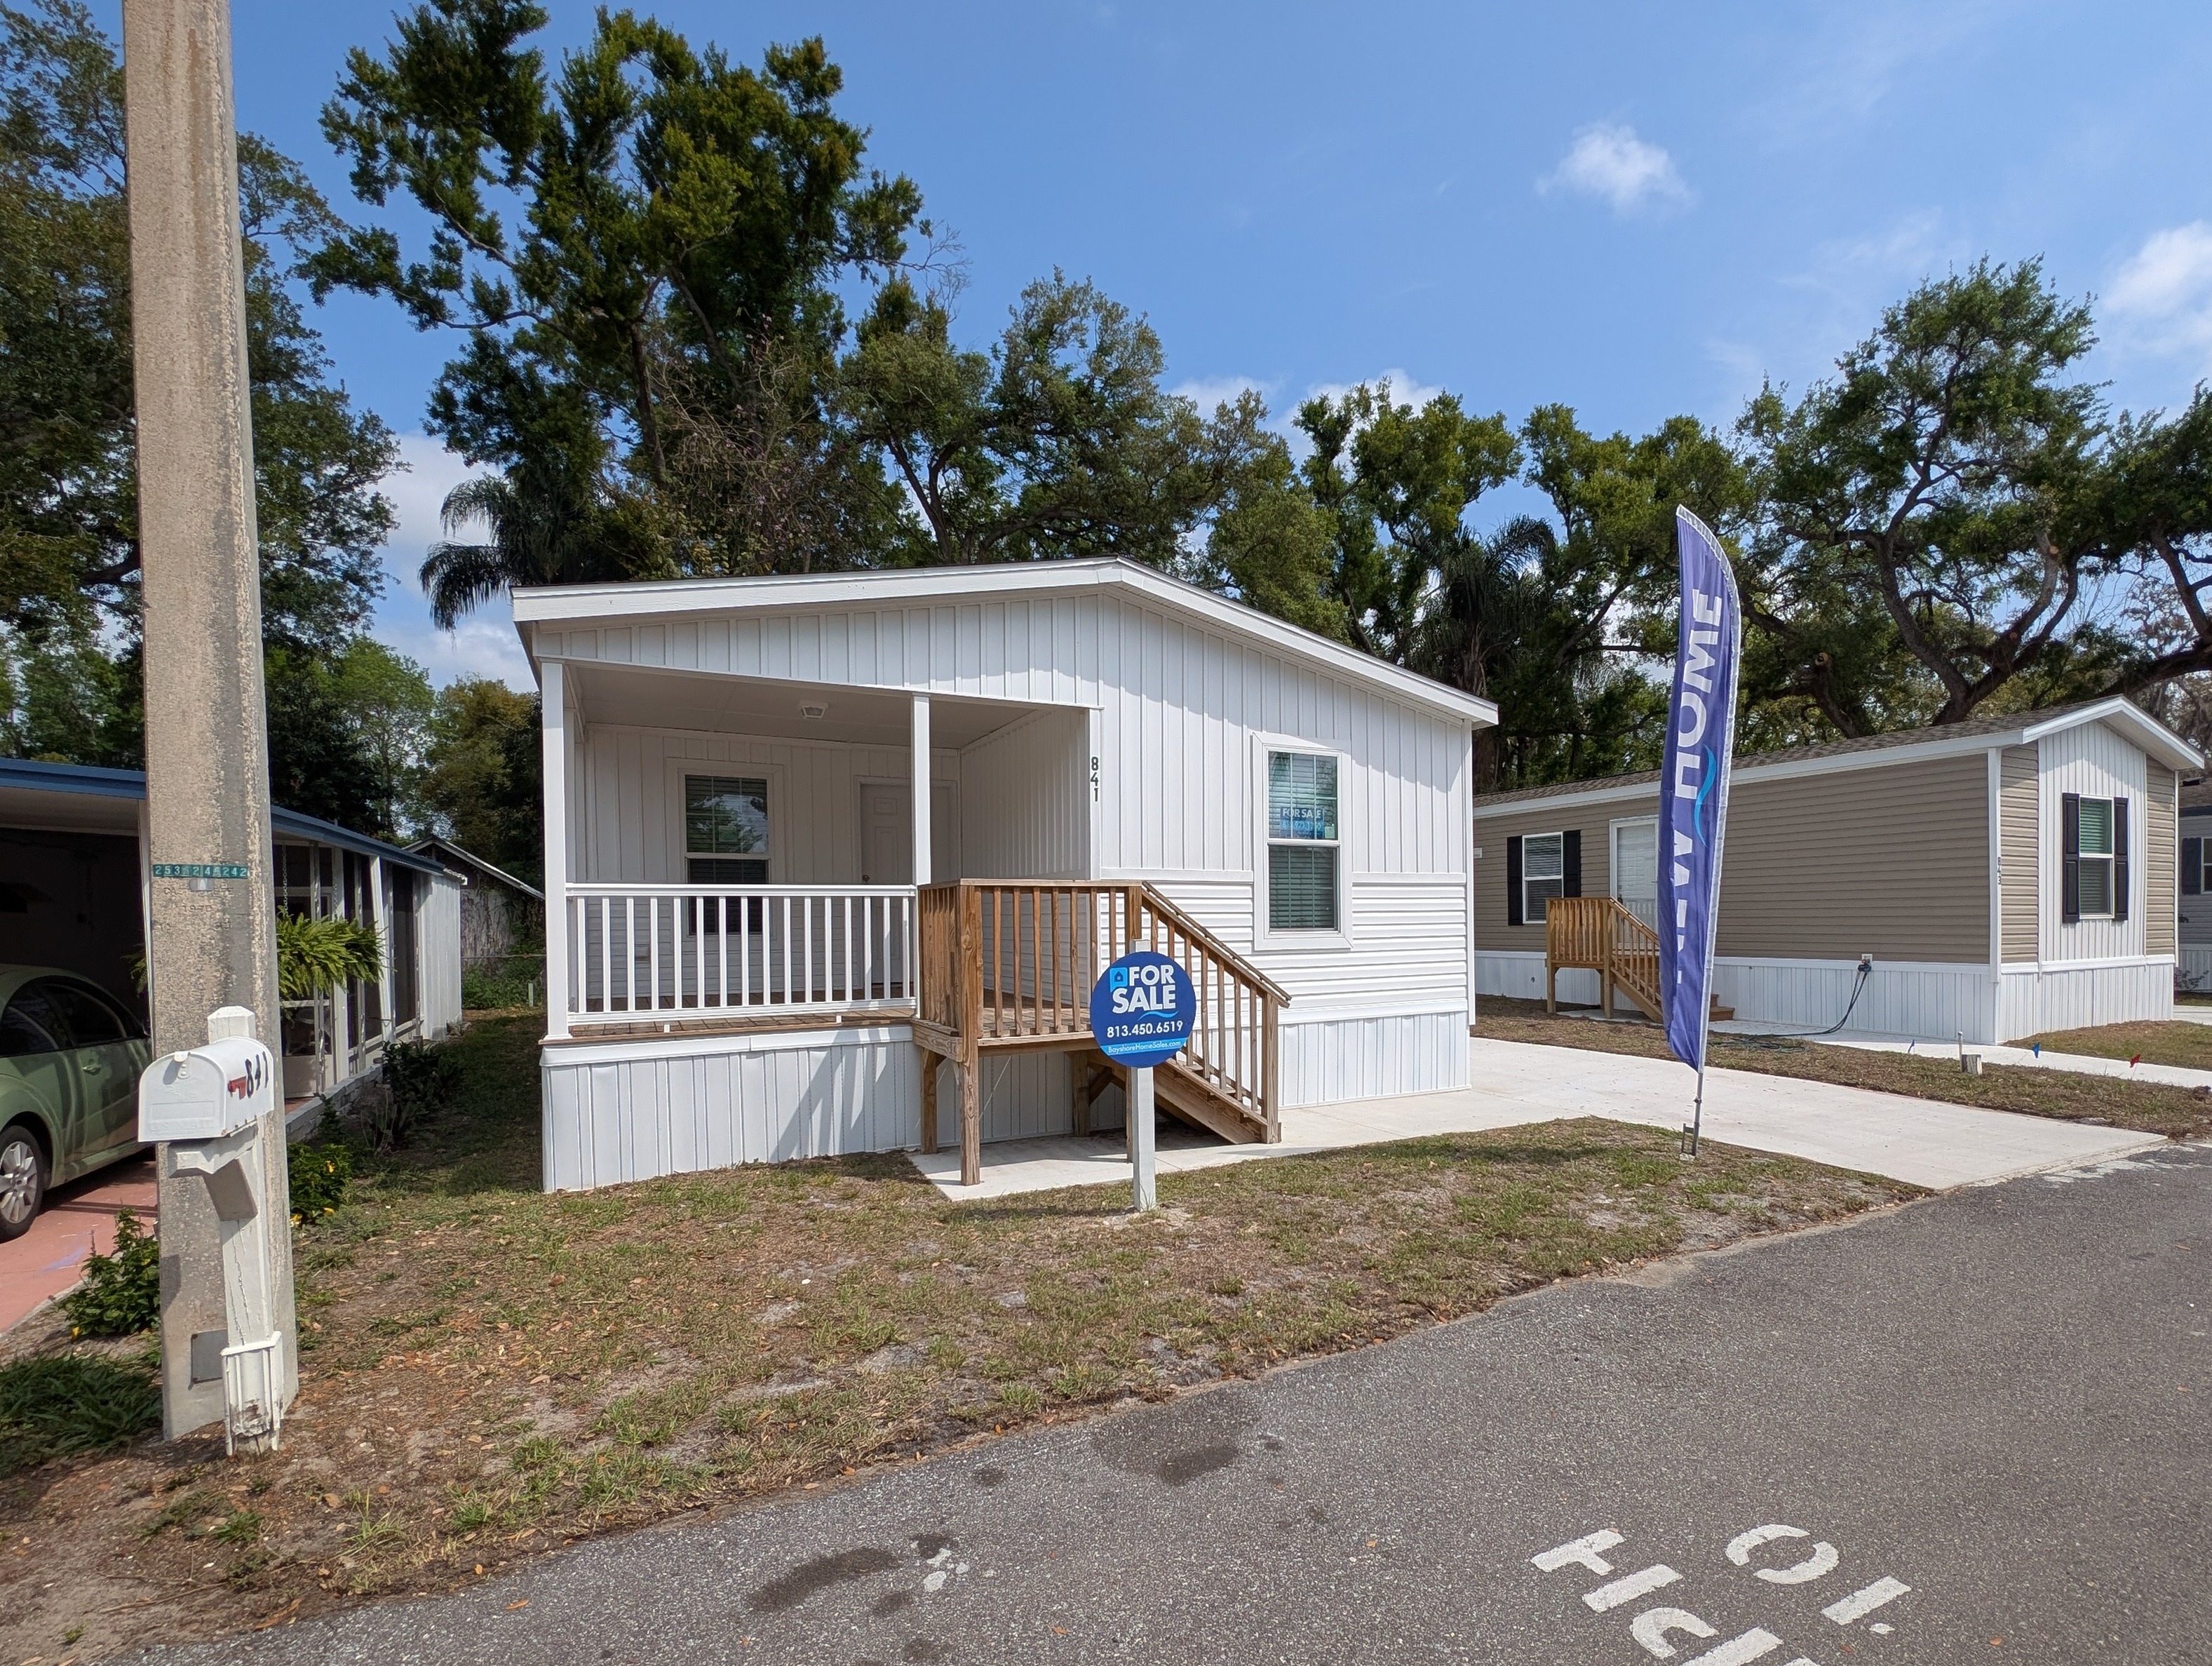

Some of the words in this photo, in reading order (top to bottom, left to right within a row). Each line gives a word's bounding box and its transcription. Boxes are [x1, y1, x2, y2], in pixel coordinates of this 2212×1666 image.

[1090, 756, 1099, 802] 841
[1283, 807, 1301, 818] FOR
[1301, 809, 1322, 819] SAE
[1128, 965, 1176, 987] FOR
[1112, 985, 1177, 1014] SALE
[1107, 1020, 1184, 1038] 813.450.6519
[1108, 1040, 1182, 1054] BayshoreHomeSales.com
[245, 1051, 269, 1099] 841
[1530, 1528, 1823, 1666] PH
